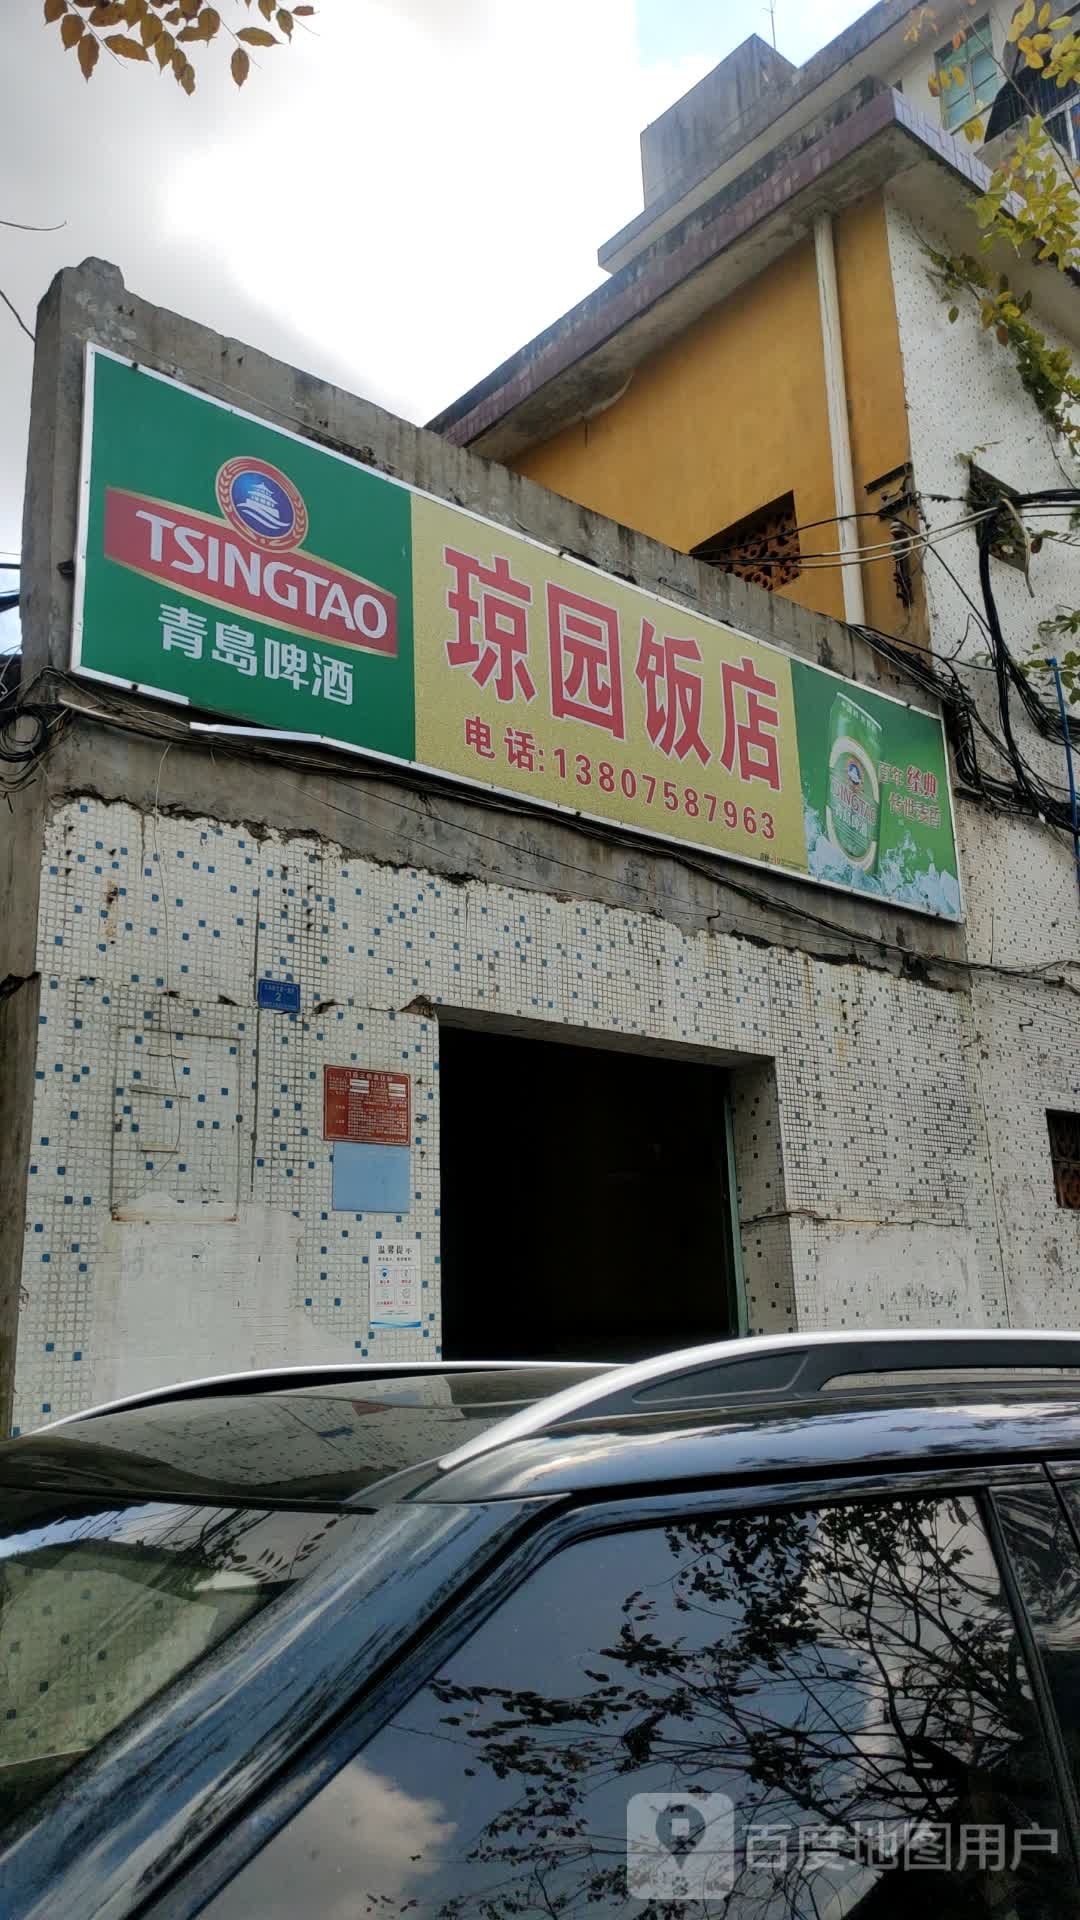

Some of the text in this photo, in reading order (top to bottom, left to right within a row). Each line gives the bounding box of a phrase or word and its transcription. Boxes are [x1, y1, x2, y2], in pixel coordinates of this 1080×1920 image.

[135, 510, 388, 640] TSINGTAO
[443, 545, 782, 791] 琼园饭店
[275, 991, 282, 1002] 2
[377, 1244, 413, 1255] 温馨提示
